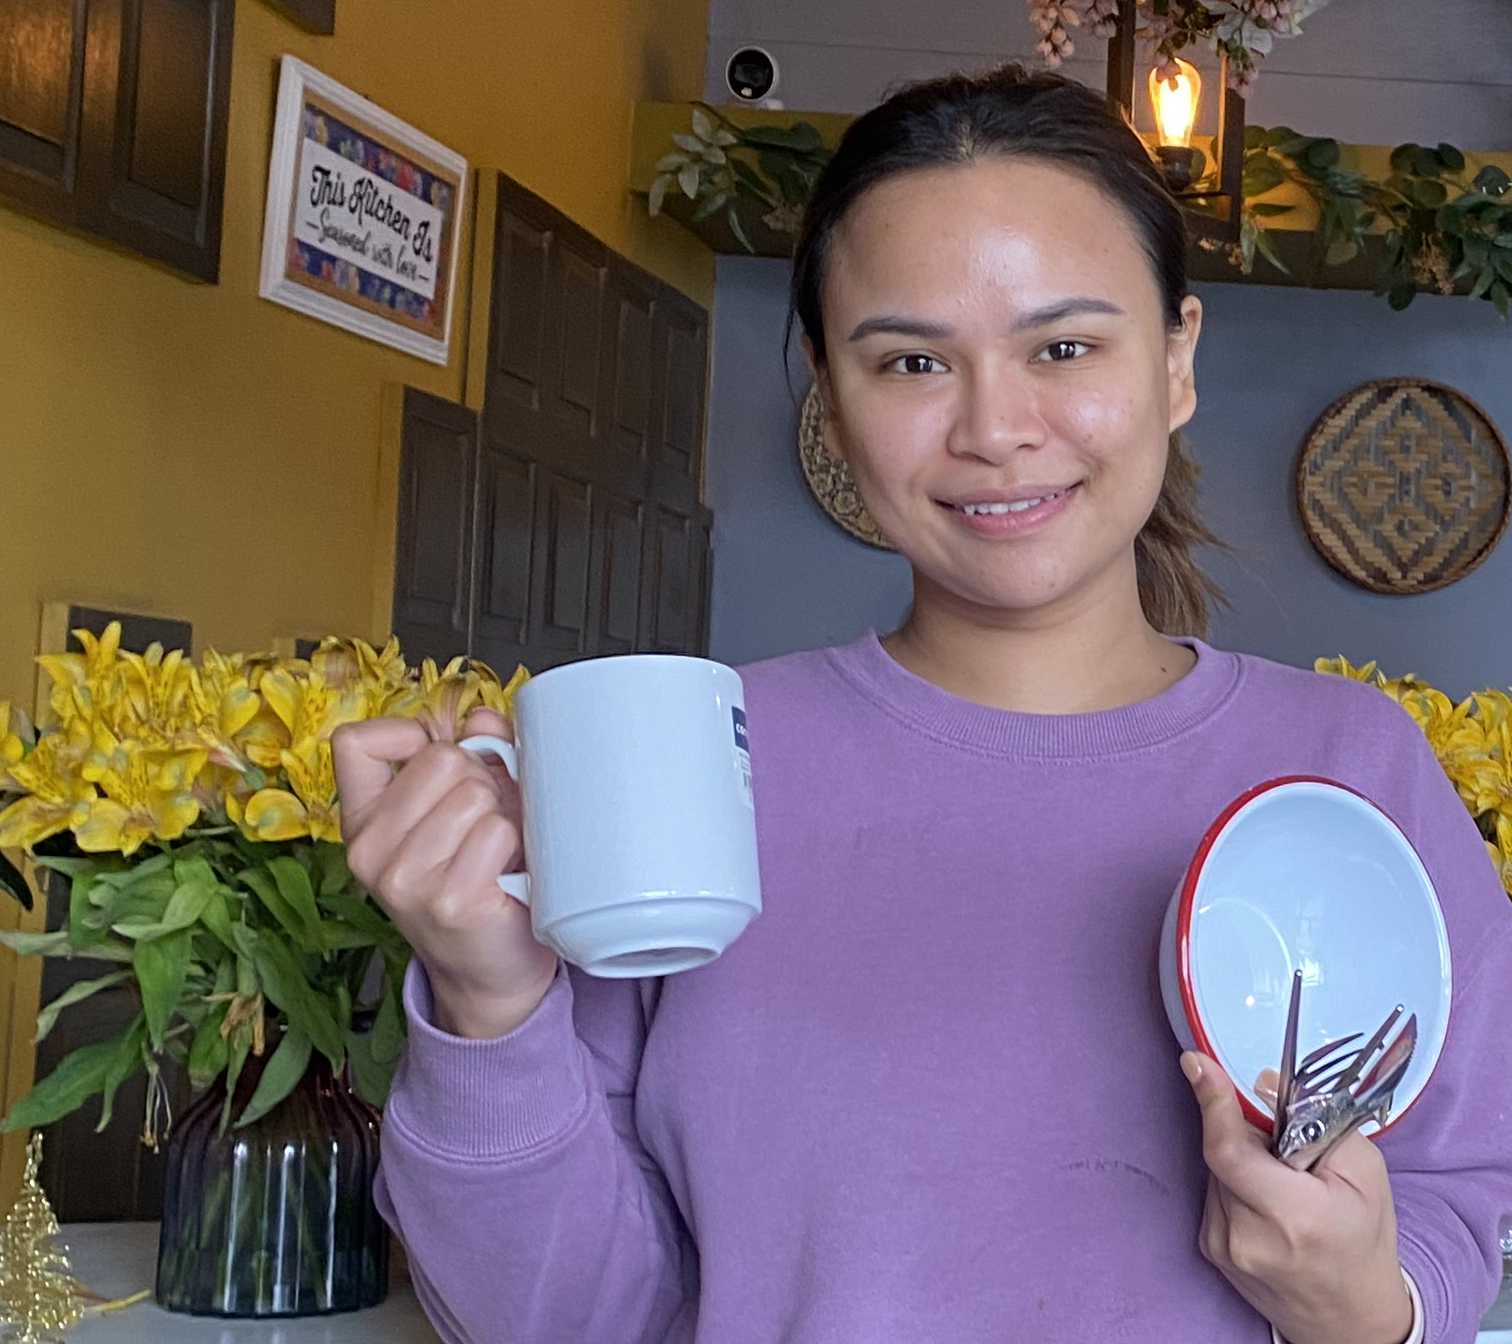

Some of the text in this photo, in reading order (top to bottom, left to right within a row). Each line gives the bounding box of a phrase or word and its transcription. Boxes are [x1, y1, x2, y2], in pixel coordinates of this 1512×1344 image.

[310, 164, 433, 262] This Kitchen Is
